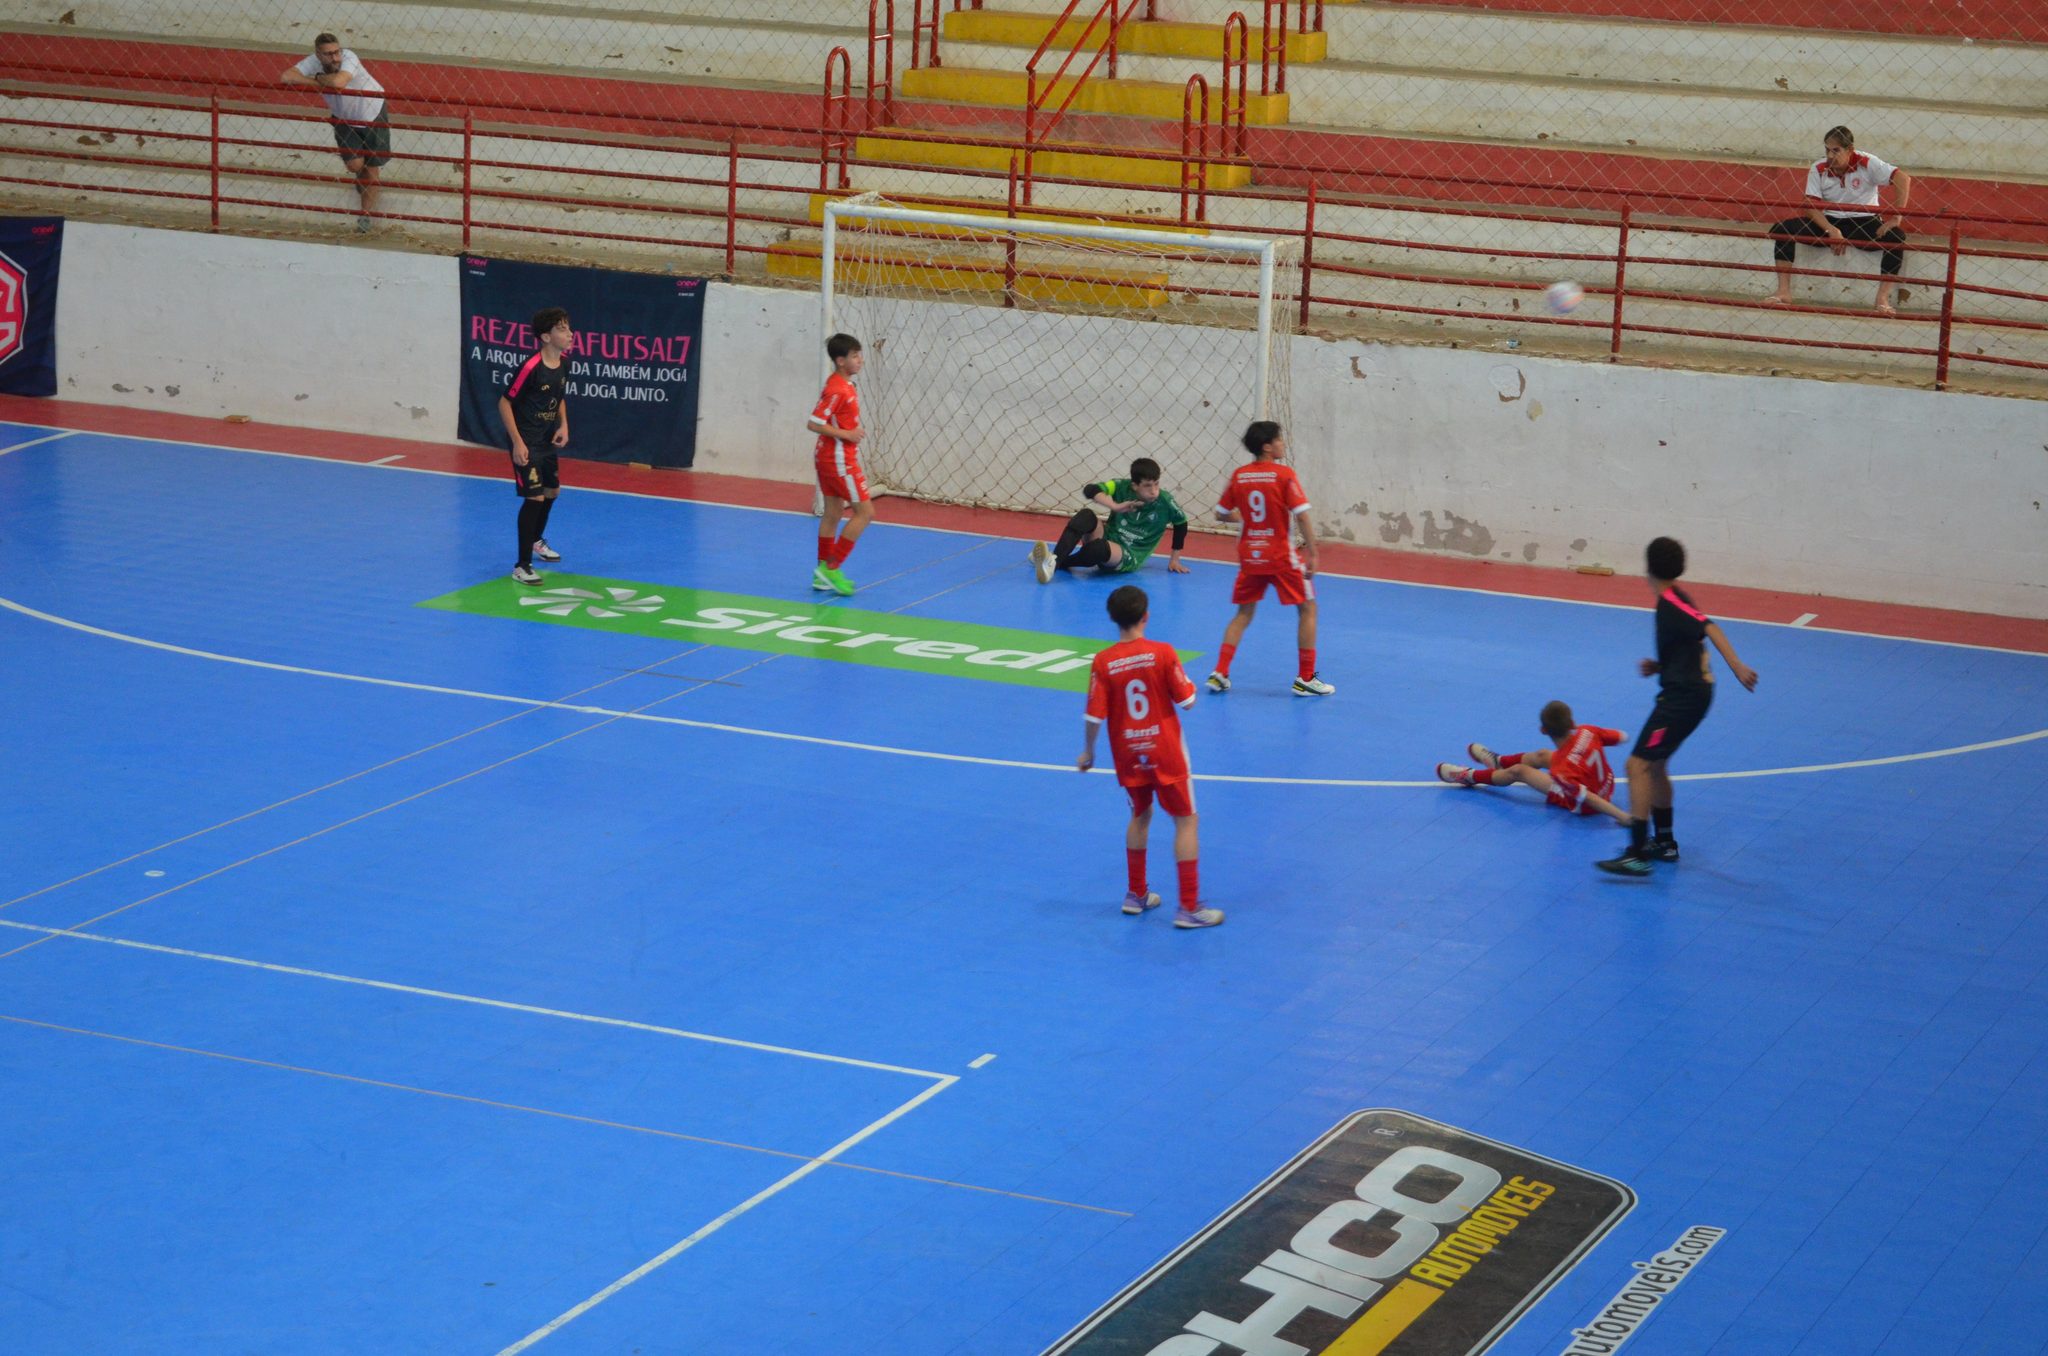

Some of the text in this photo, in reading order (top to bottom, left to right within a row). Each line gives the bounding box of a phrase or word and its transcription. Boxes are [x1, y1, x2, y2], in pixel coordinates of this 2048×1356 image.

[471, 346, 481, 360] A
[594, 363, 651, 380] TAMBÉM
[653, 368, 687, 382] JOGA
[492, 370, 500, 384] E
[581, 383, 617, 399] JOGA
[621, 386, 669, 402] JUNTO.
[1248, 490, 1266, 523] 9
[660, 607, 1097, 674] Sicredi
[1125, 679, 1150, 720] 6
[1586, 749, 1604, 783] 7
[1562, 1226, 1723, 1356] utomoveis.com
